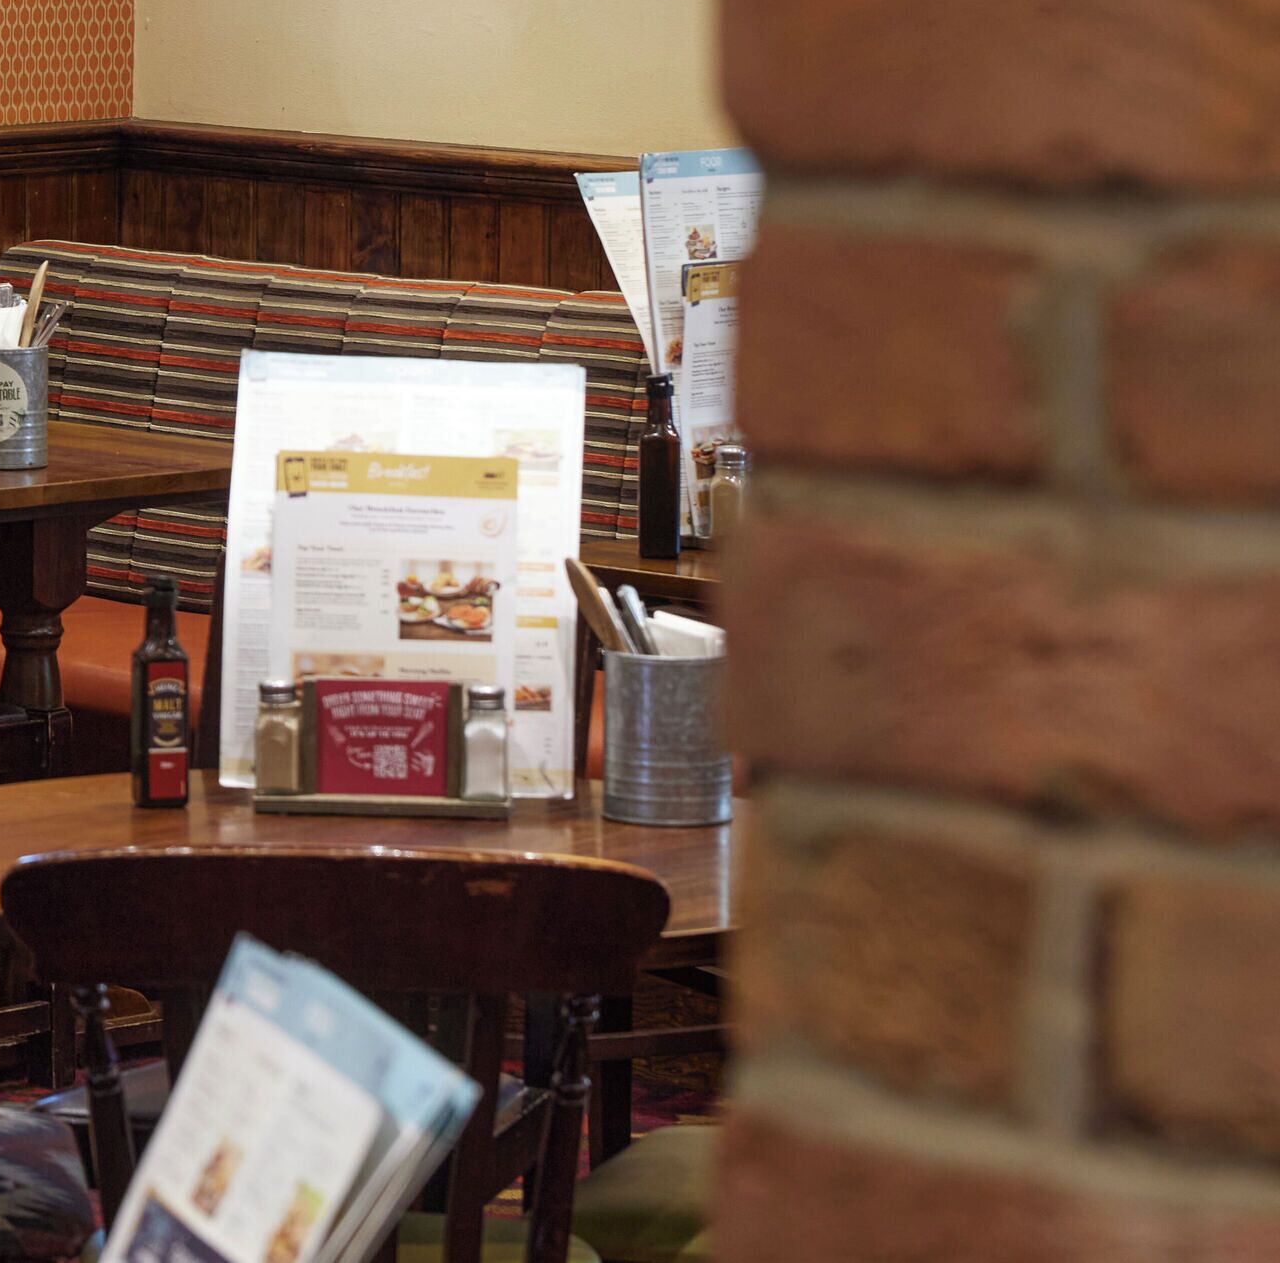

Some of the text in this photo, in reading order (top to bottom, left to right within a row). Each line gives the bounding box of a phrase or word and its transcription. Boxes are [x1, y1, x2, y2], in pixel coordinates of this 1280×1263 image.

[700, 157, 722, 167] FOOD
[368, 462, 432, 480] Breakfast
[153, 698, 182, 711] MALT
